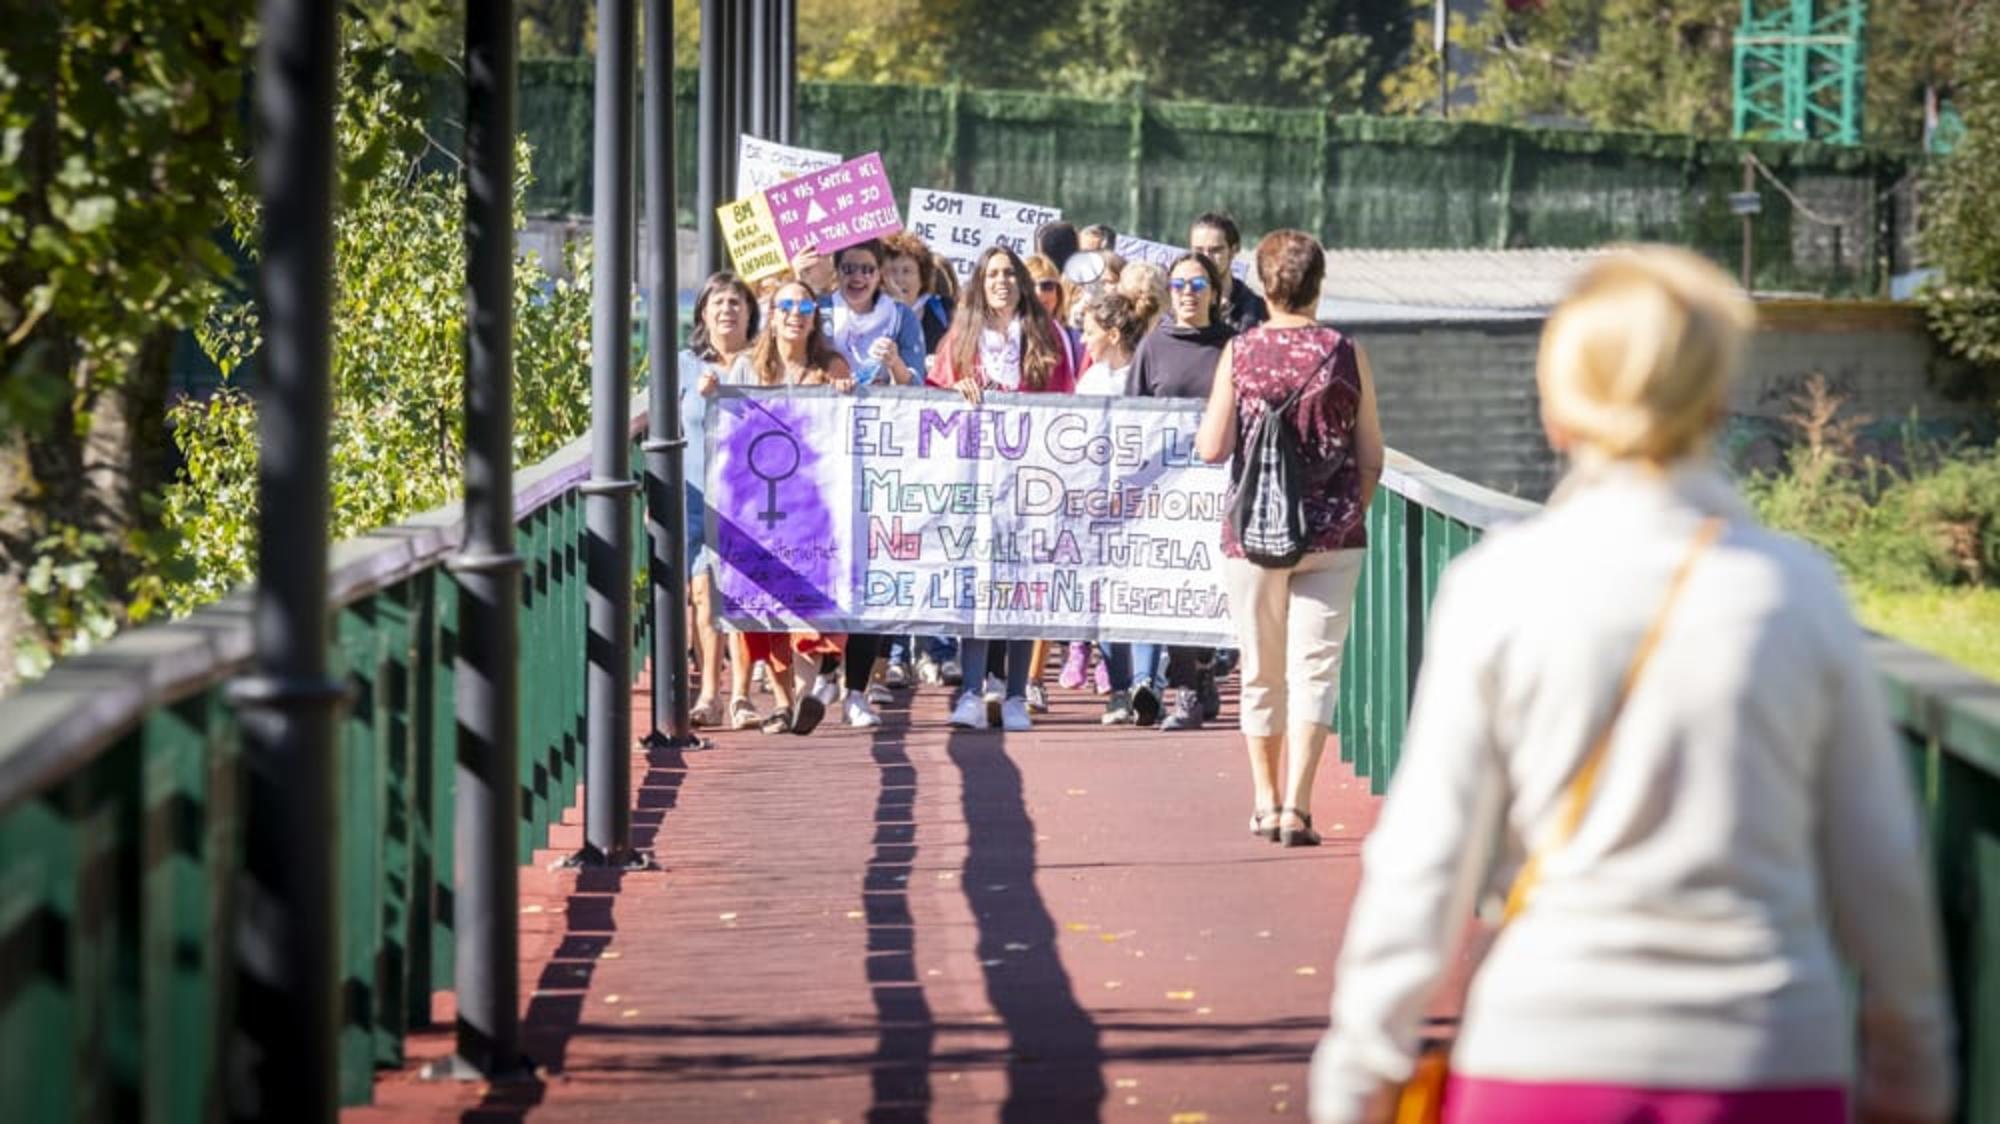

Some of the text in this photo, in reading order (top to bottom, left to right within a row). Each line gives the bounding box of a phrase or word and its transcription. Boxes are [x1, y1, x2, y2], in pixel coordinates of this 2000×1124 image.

[770, 189, 788, 206] TU
[791, 181, 815, 200] VAS
[922, 192, 963, 215] SOM
[980, 202, 1000, 219] EL
[915, 221, 937, 240] DE
[951, 226, 982, 247] LES
[846, 406, 903, 457] EL
[918, 408, 1031, 460] MEU
[860, 468, 993, 514] MEVES
[937, 526, 1021, 563] VULL
[1032, 528, 1082, 564] LA
[1089, 521, 1212, 570] TUTELA
[864, 570, 916, 606] DE
